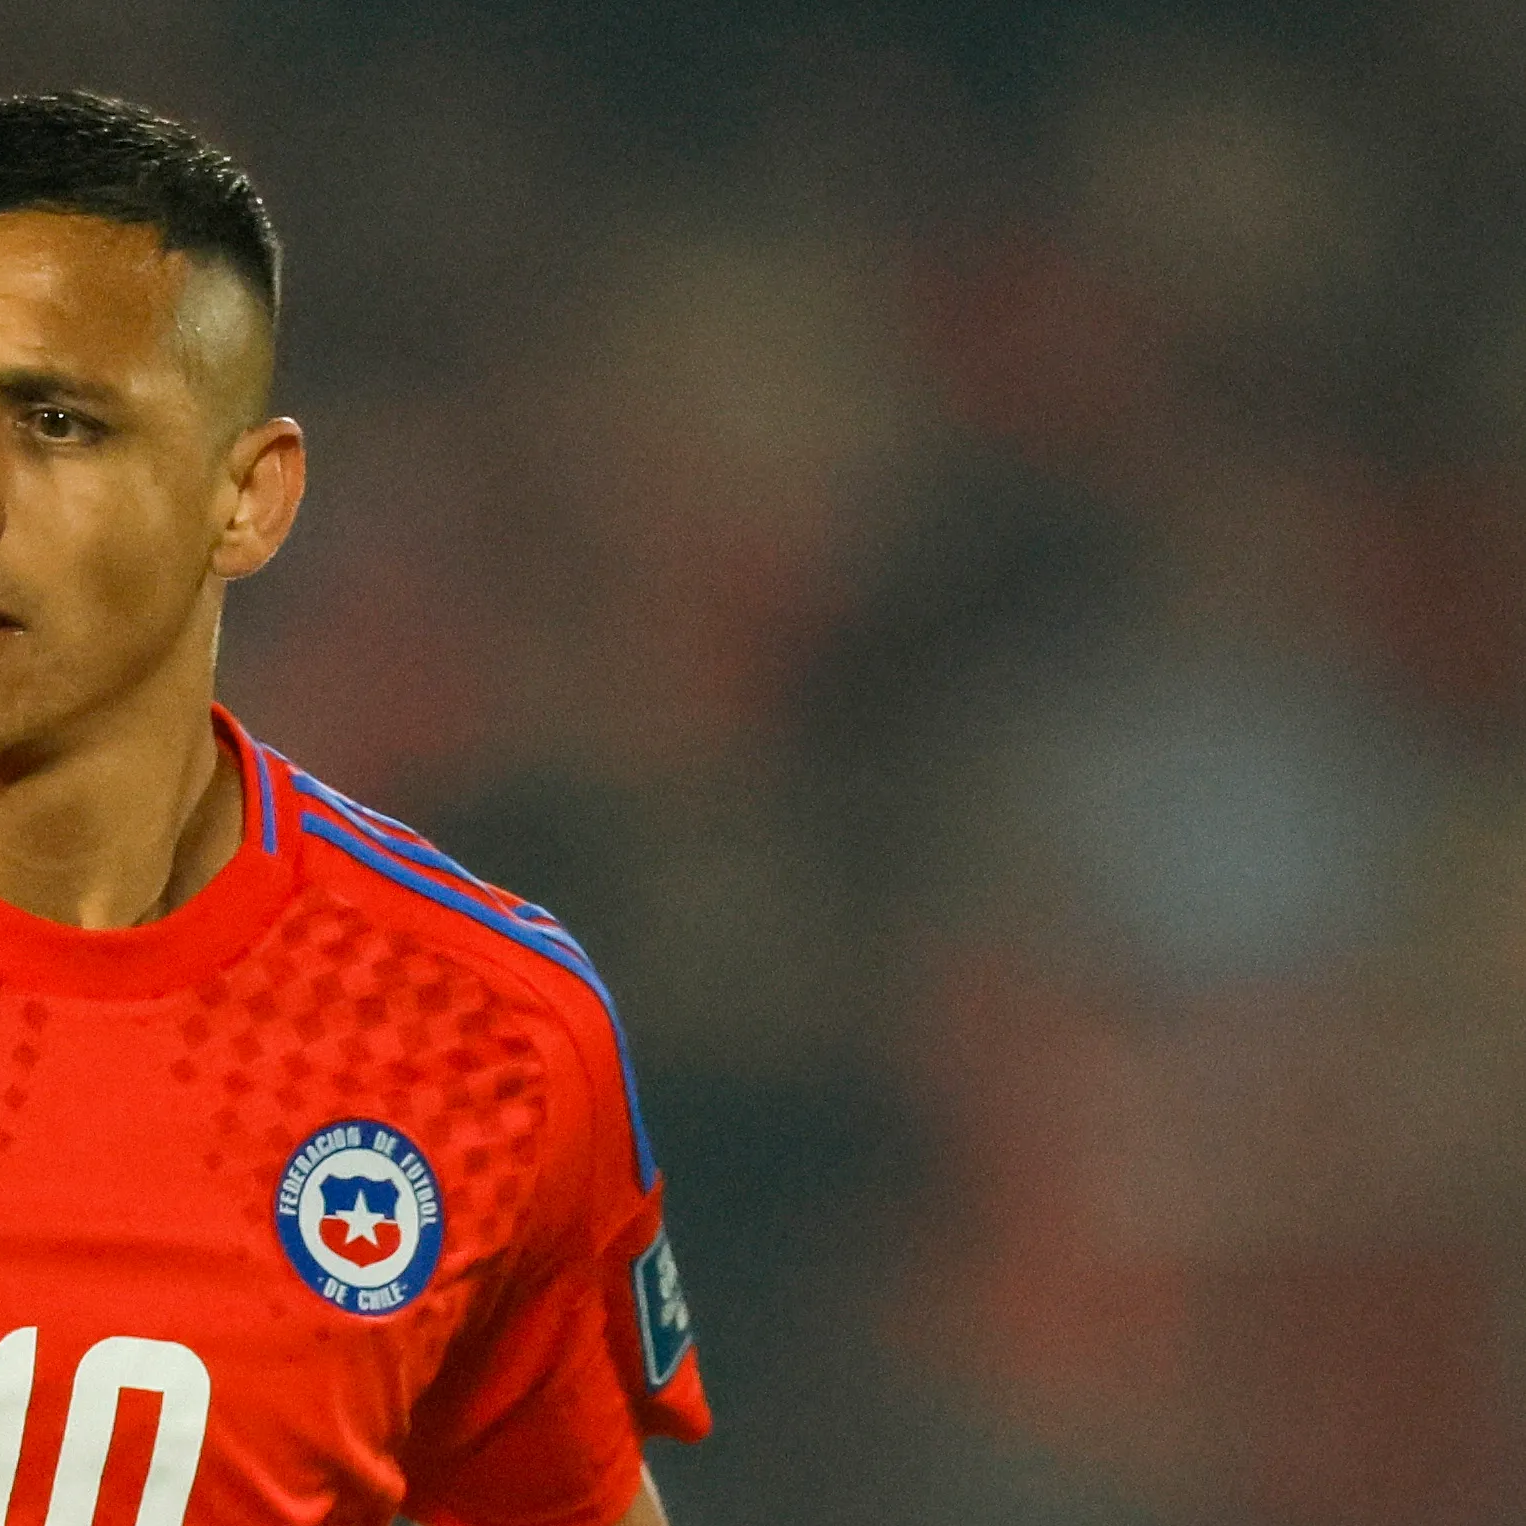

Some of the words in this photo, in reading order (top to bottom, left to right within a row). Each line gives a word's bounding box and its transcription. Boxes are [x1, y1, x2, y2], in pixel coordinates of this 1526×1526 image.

[373, 1130, 397, 1153] DE
[323, 1276, 348, 1306] DE
[357, 1284, 405, 1312] CHILE
